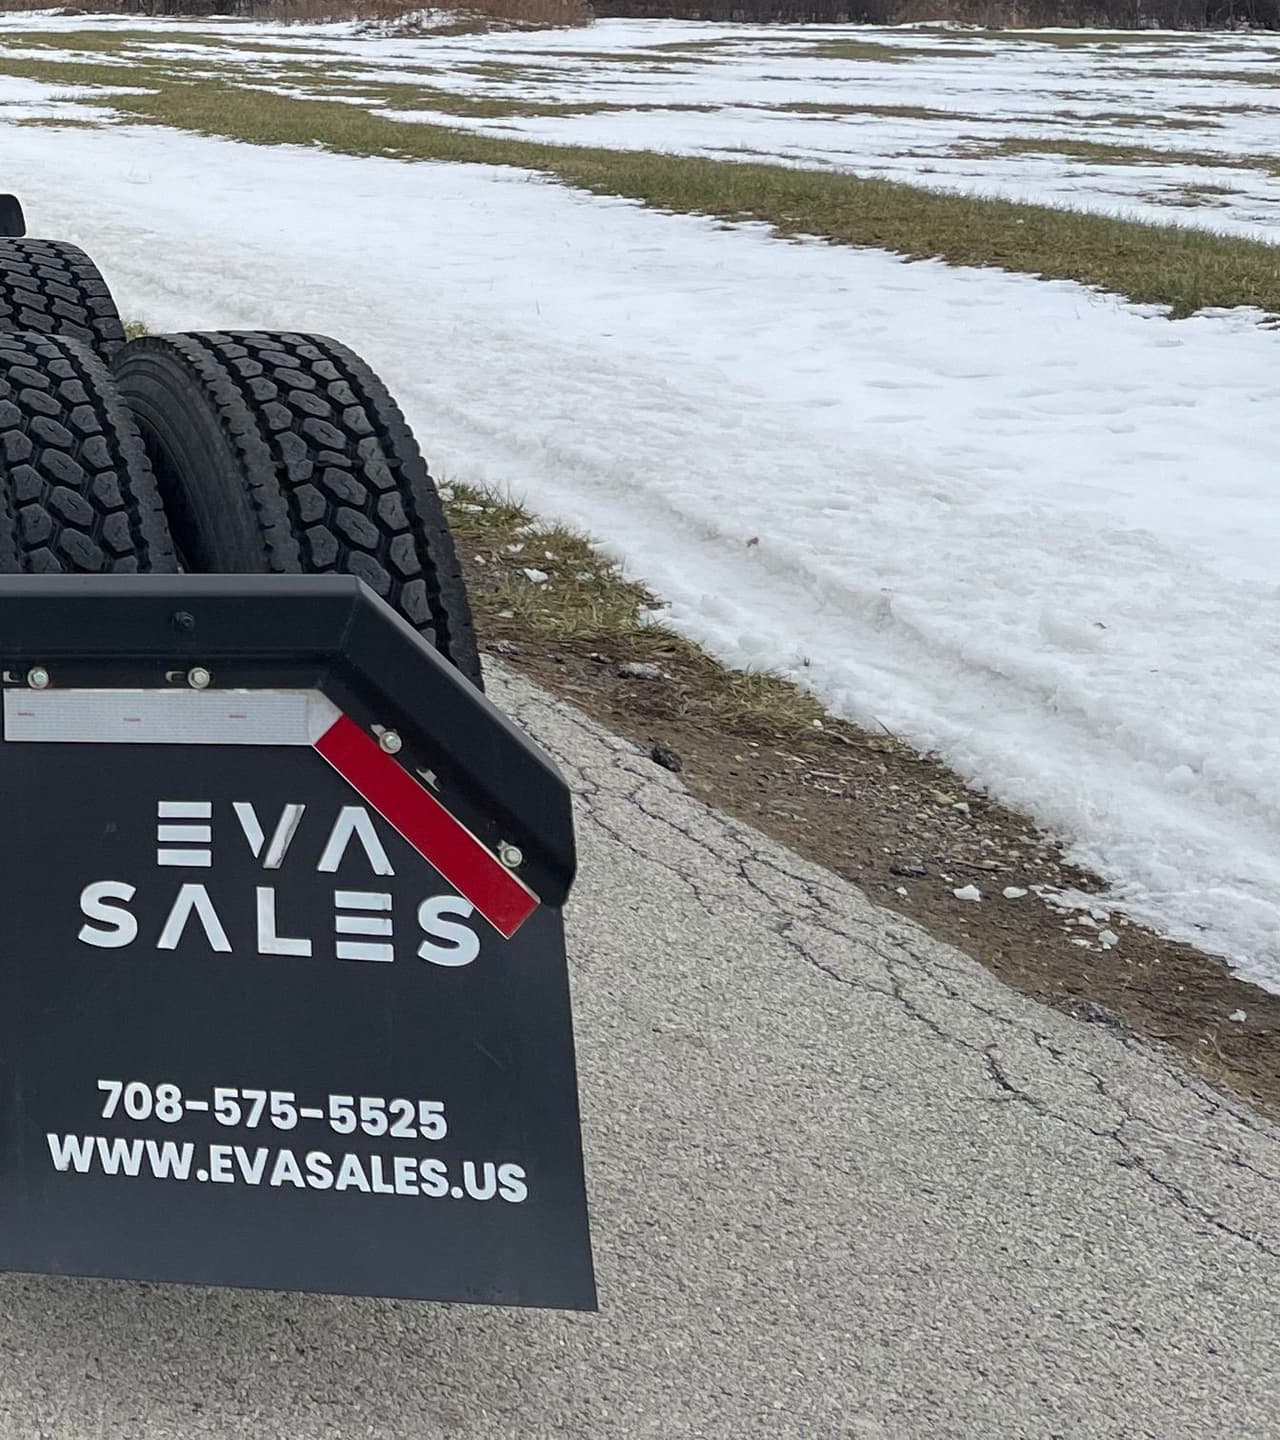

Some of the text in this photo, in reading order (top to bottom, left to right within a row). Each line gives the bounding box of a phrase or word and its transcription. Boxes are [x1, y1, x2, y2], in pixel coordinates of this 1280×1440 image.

[157, 800, 396, 876] EVA
[78, 880, 481, 967] SALES
[97, 1079, 448, 1140] 708-575-5525
[46, 1133, 528, 1203] WWW.EVASALES.US
